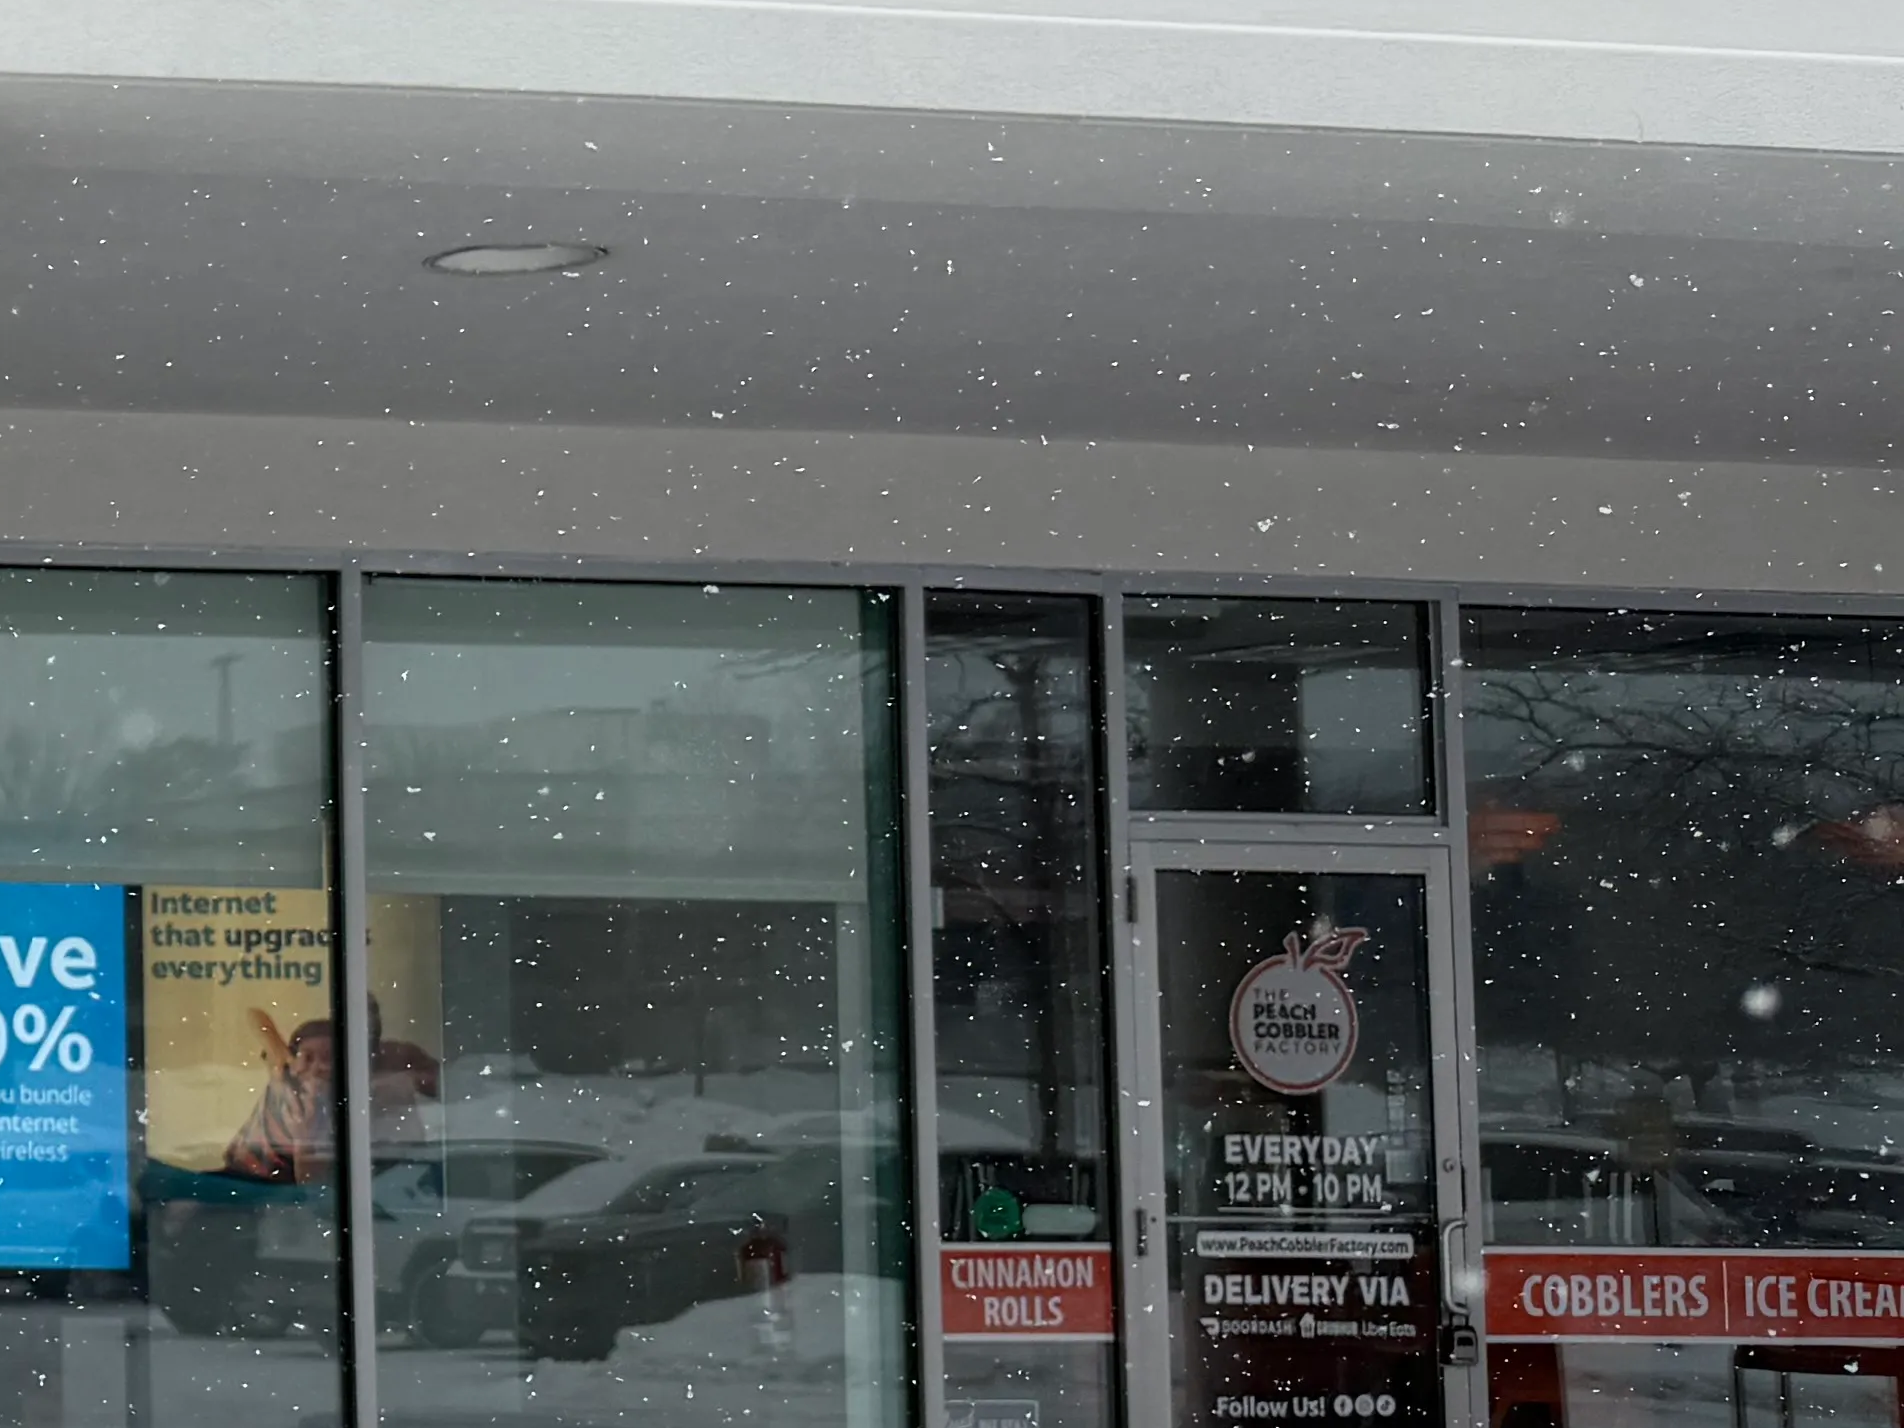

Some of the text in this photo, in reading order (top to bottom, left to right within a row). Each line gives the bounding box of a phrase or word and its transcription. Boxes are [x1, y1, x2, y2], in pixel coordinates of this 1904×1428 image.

[151, 892, 277, 915] Internet
[150, 924, 216, 946] that
[152, 954, 322, 985] everything
[1254, 988, 1290, 1001] THE
[1253, 1004, 1317, 1020] PEACH
[1253, 1022, 1340, 1039] COBBLER
[1254, 1041, 1341, 1055] FACTORY
[20, 1083, 91, 1106] bundle
[1224, 1134, 1378, 1165] EVERYDAY
[1224, 1173, 1382, 1203] 12 PM 10 PM
[1200, 1237, 1408, 1256] www.PeachCobblerFactory.com
[951, 1255, 1093, 1288] CINNAMON
[1204, 1275, 1411, 1306] DELIVERY VIA
[1523, 1275, 1709, 1317] COBBLERS
[1745, 1275, 1904, 1318] ICE CREA
[984, 1296, 1064, 1326] ROLLS
[1216, 1397, 1326, 1418] Follow Us!
